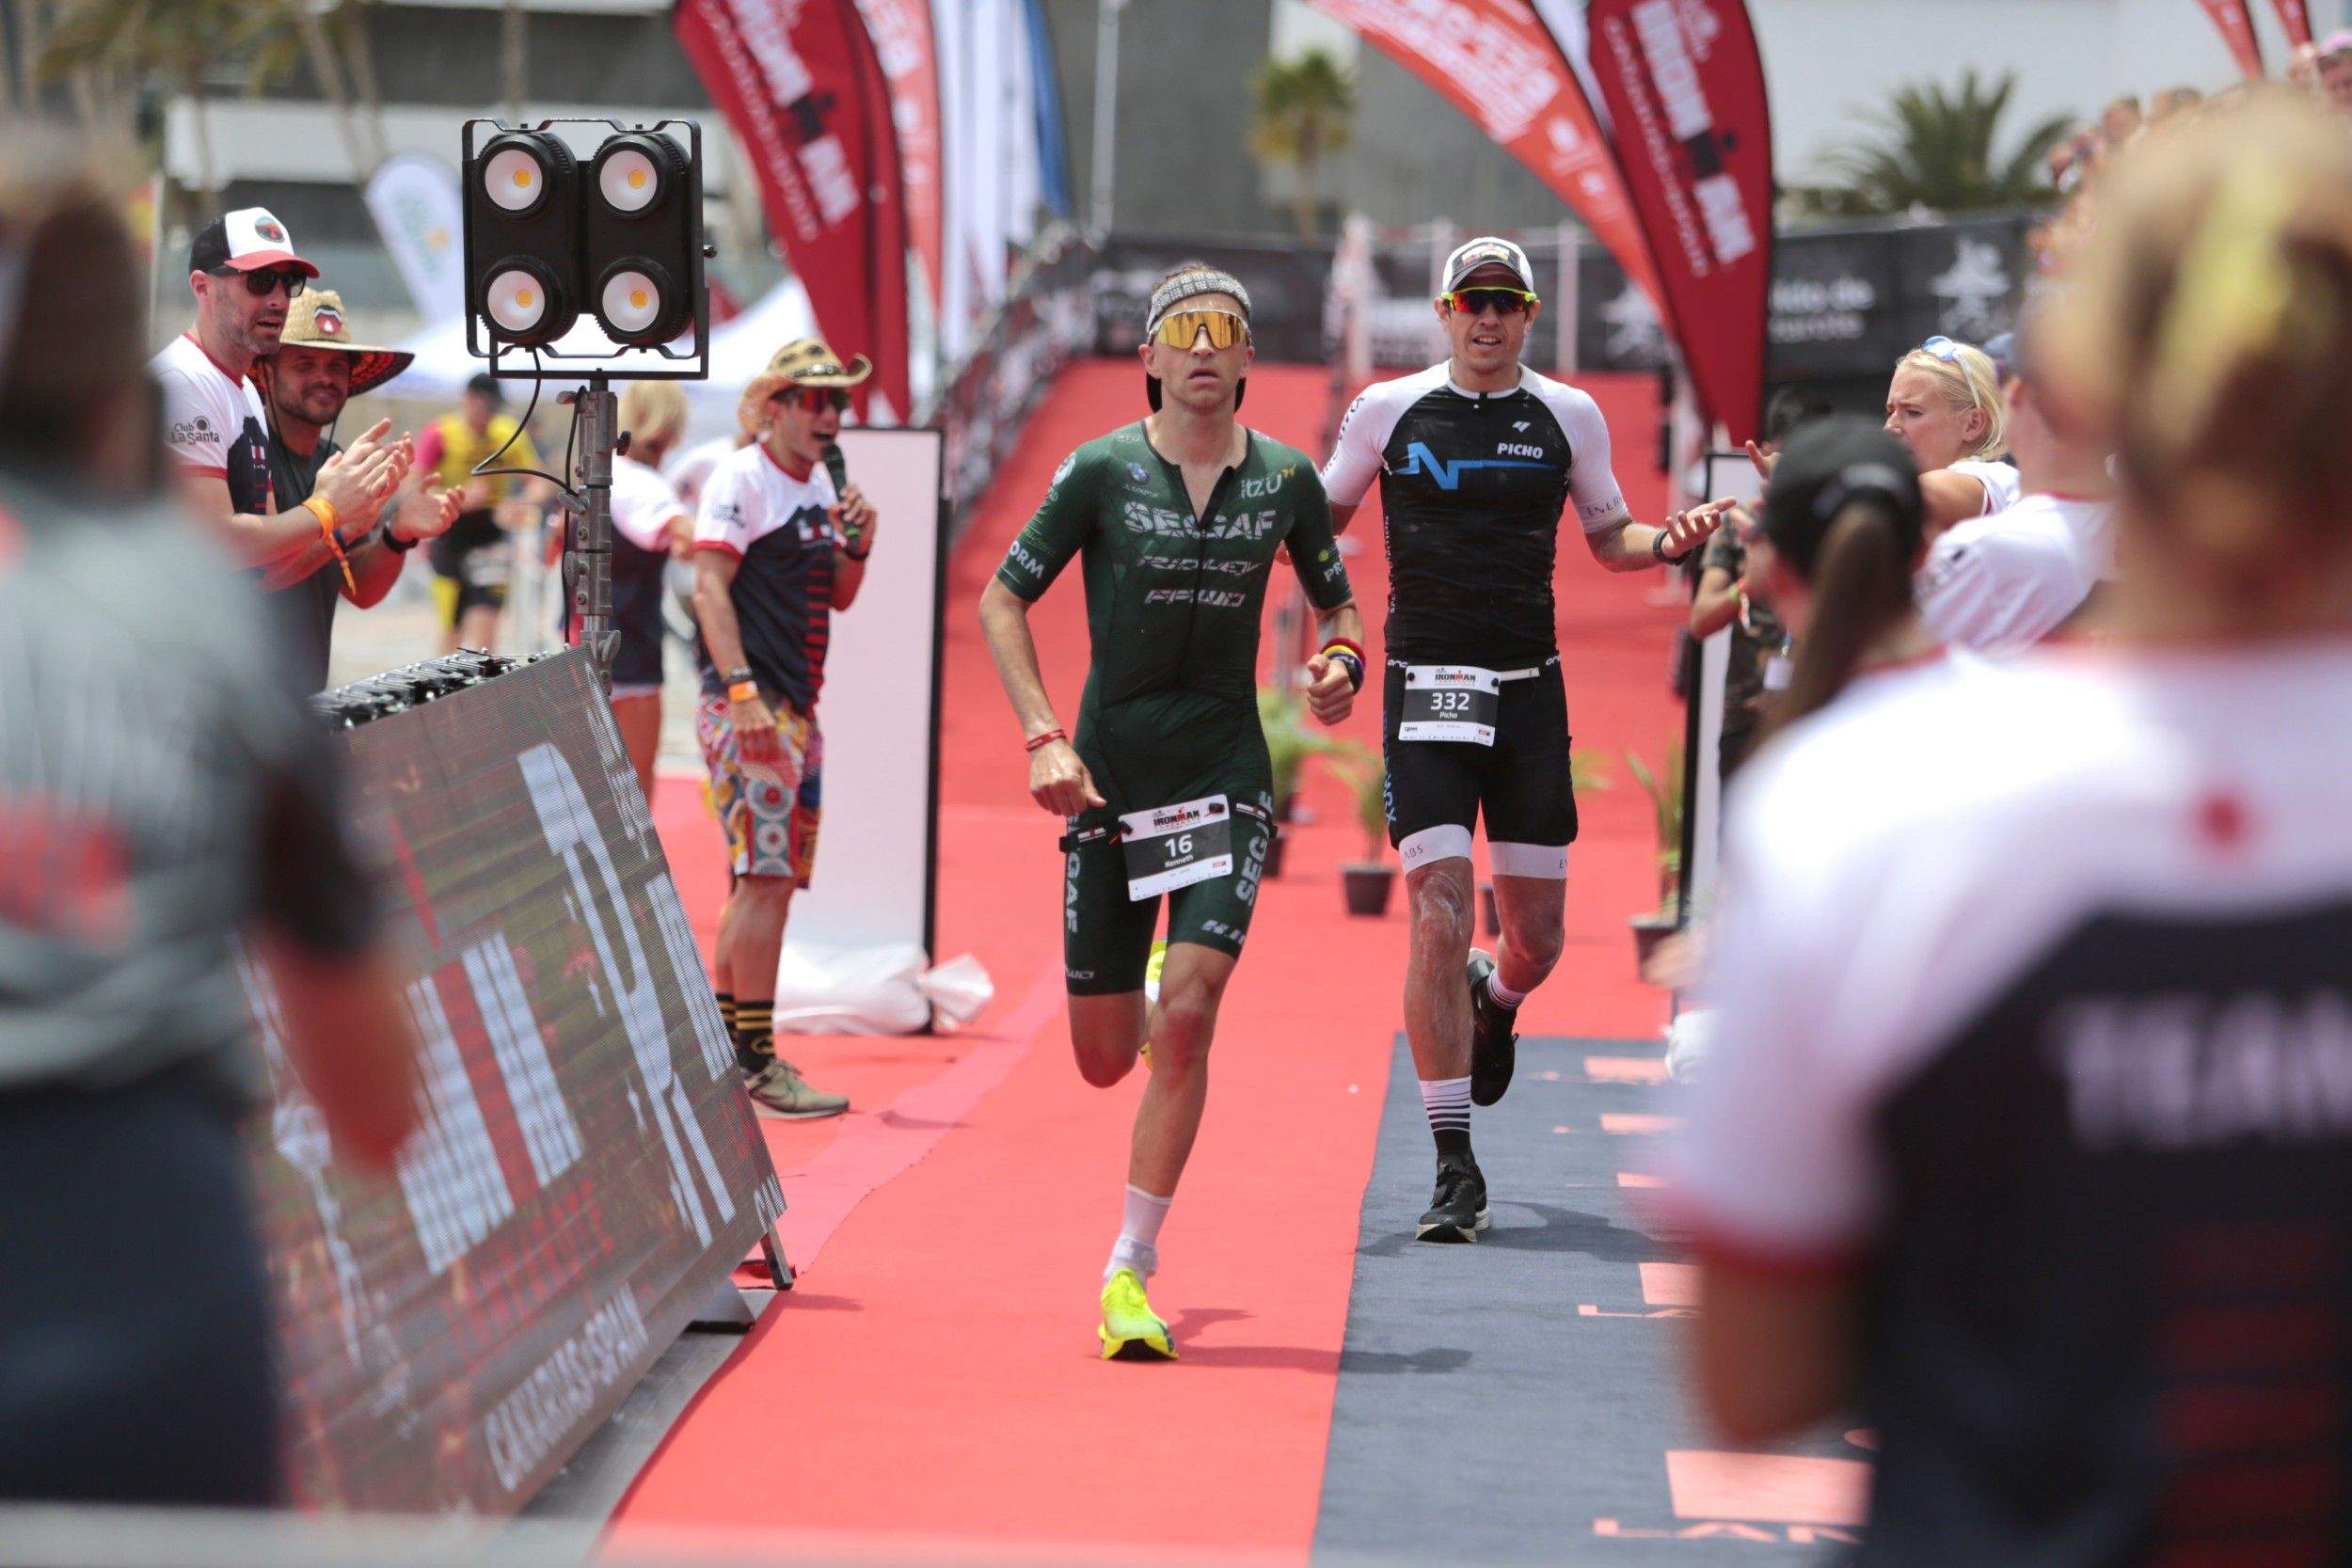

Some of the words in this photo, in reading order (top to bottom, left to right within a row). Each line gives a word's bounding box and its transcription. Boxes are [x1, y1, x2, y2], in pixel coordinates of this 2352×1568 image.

[174, 421, 194, 433] Club
[1497, 442, 1544, 459] PICHO
[1435, 672, 1476, 682] IRONMAN
[1430, 692, 1470, 711] 332
[1439, 711, 1458, 720] Picho
[1153, 809, 1200, 827] IRONMAN
[1165, 833, 1194, 858] 16
[1164, 855, 1195, 869] Kenneth
